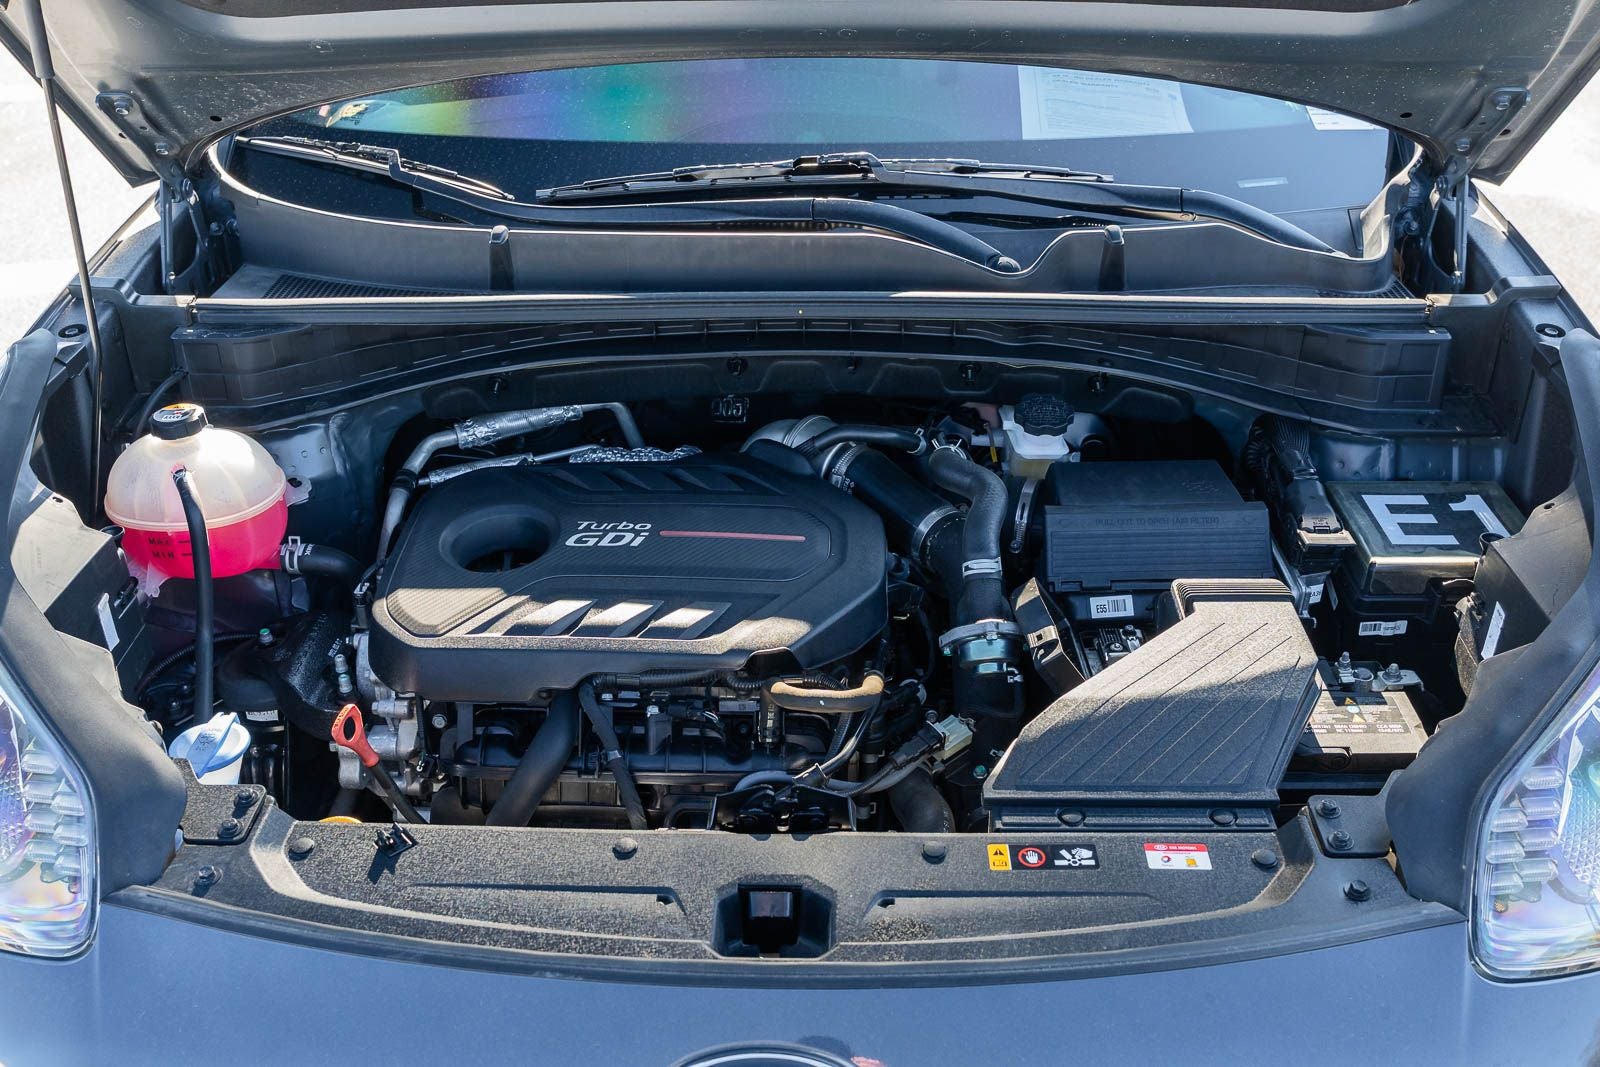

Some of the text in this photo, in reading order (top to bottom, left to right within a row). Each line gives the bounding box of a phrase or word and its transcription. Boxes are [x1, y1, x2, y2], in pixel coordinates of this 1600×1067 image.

[577, 521, 652, 530] Turbo
[1361, 494, 1511, 545] E1
[565, 532, 650, 547] GDi
